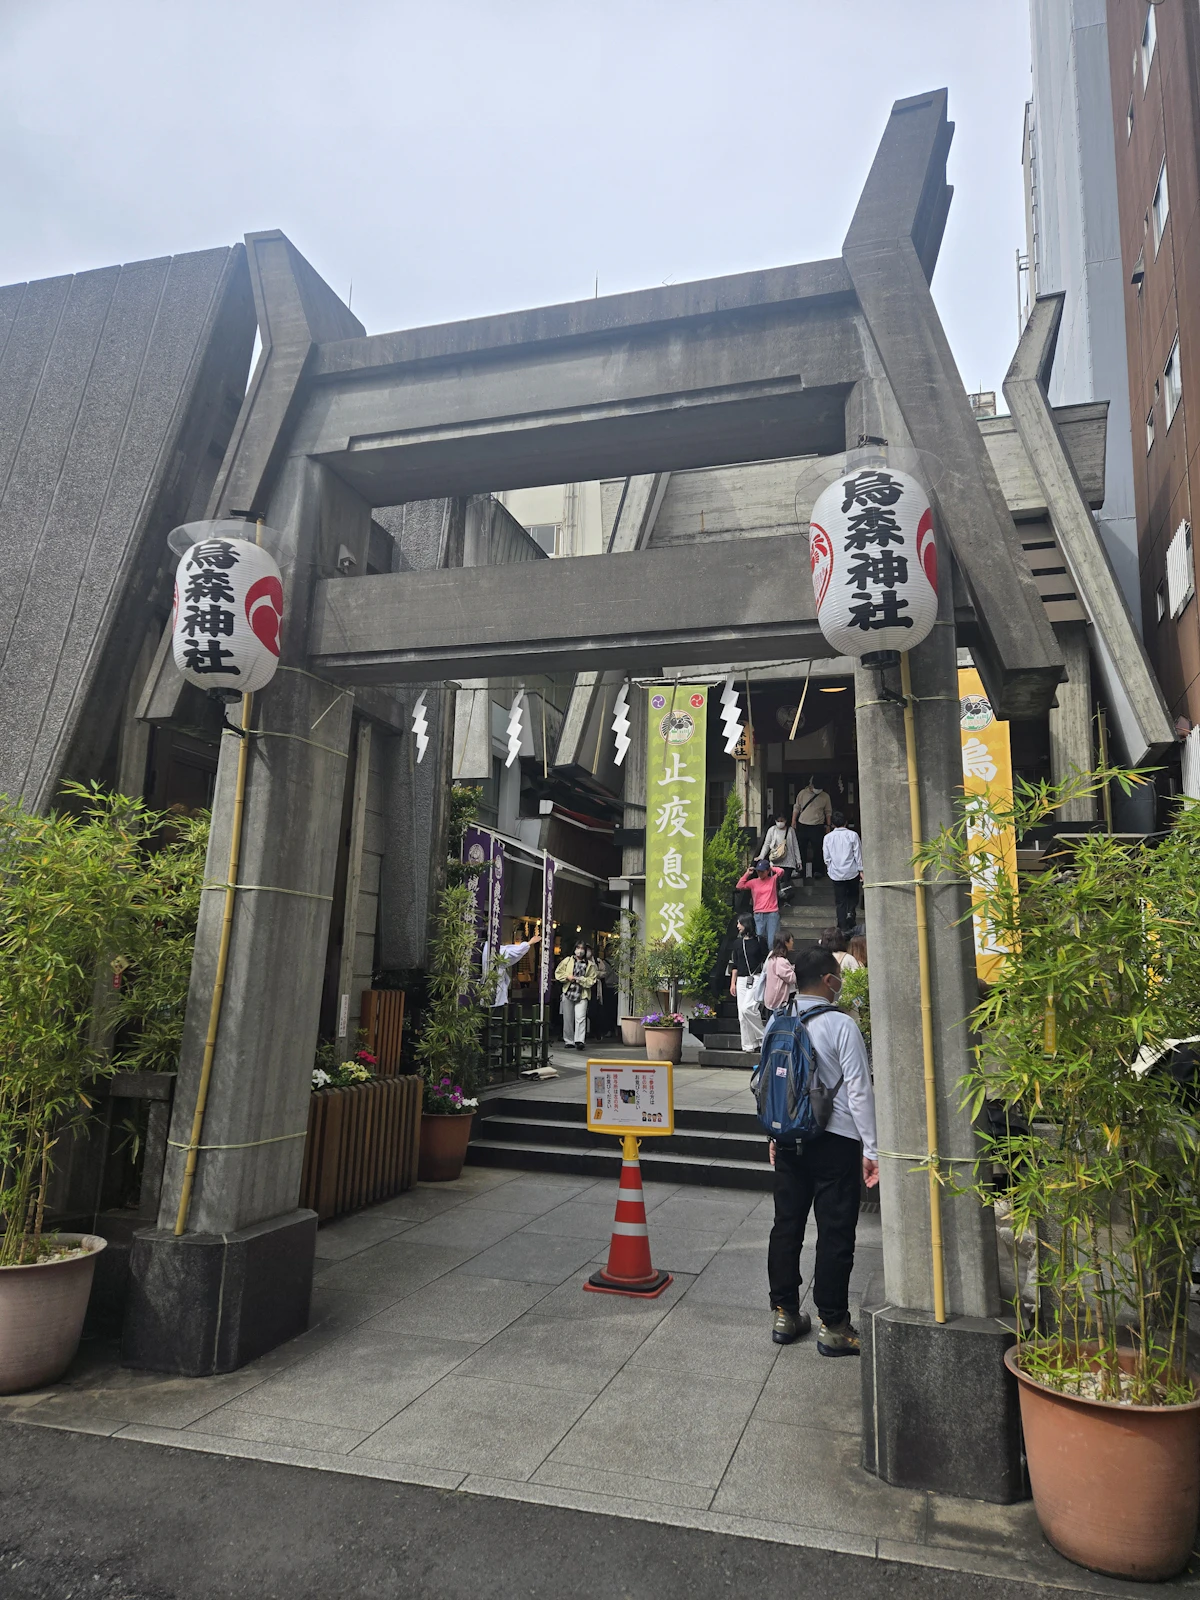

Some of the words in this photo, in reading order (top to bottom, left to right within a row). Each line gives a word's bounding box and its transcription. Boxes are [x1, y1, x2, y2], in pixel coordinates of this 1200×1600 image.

[180, 539, 242, 676] 烏森神社
[841, 470, 914, 632] 烏森神社
[654, 752, 697, 945] 止疫息災
